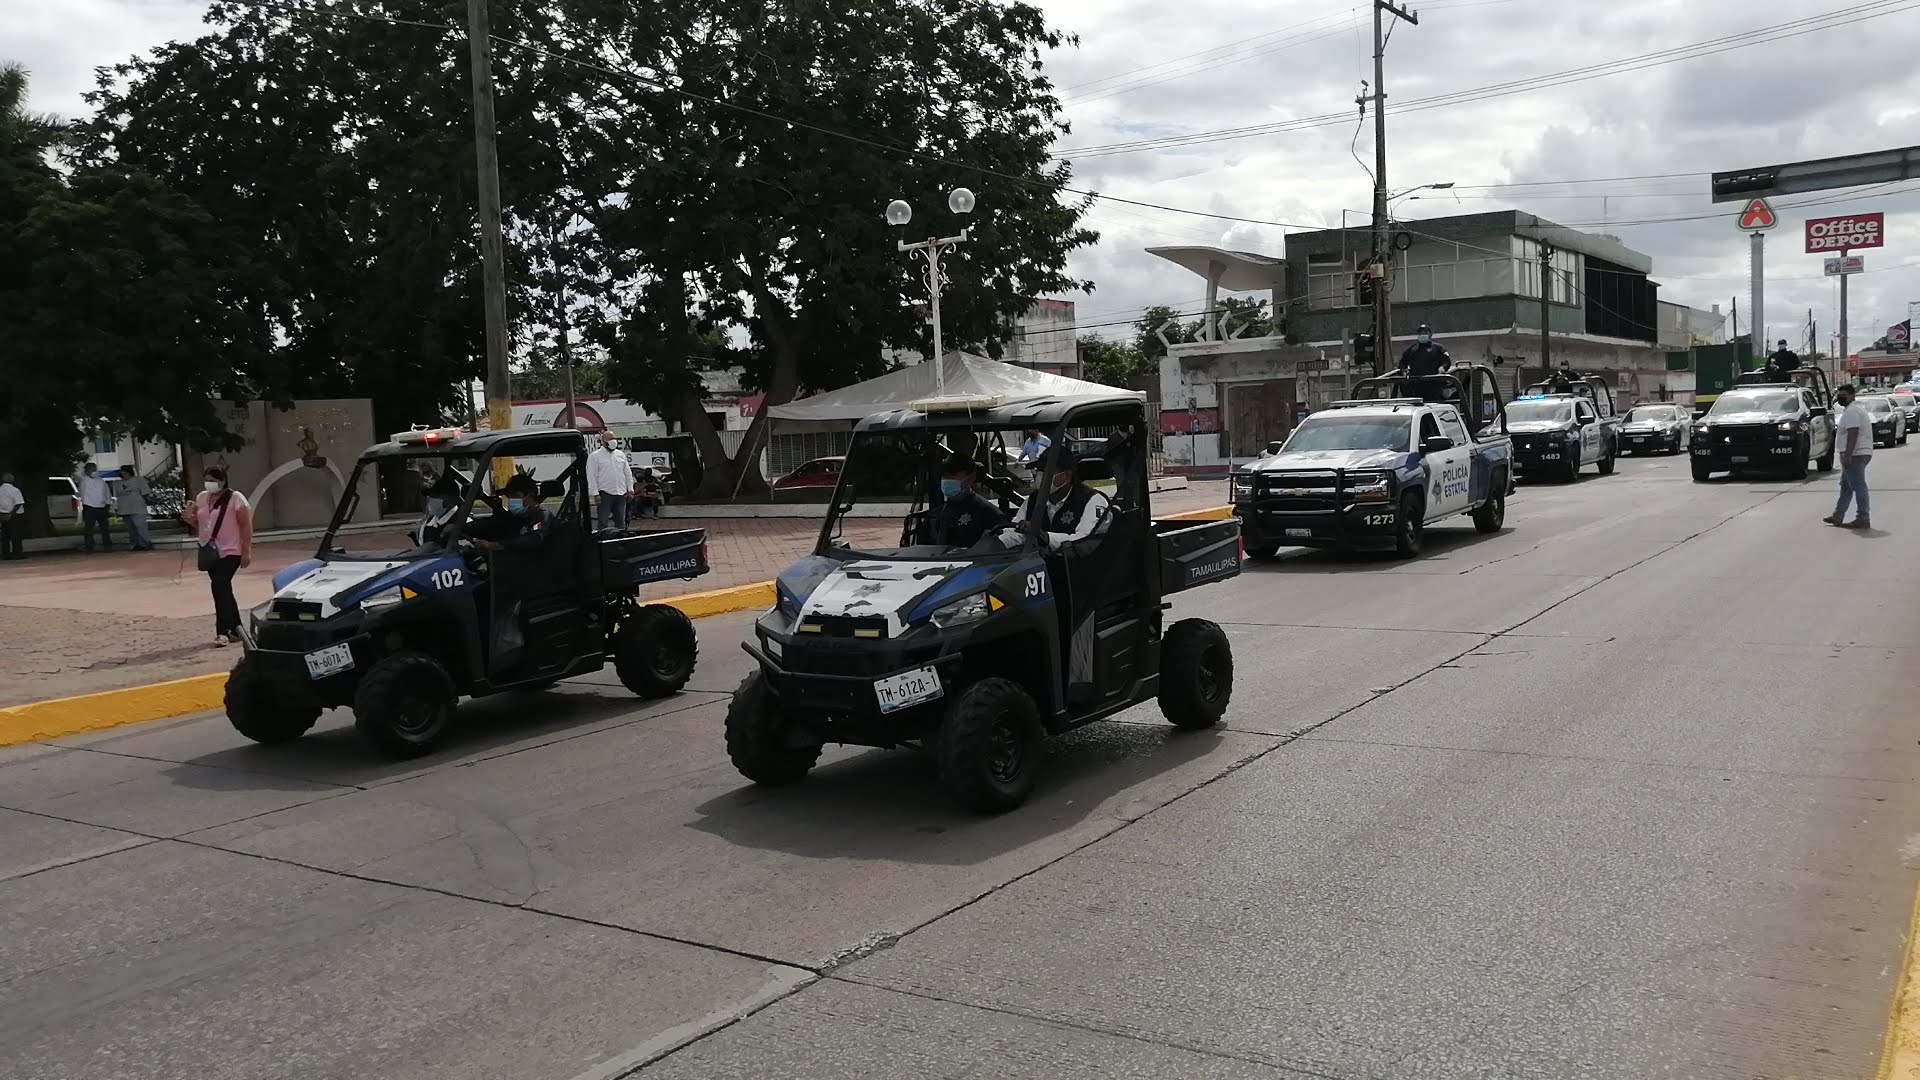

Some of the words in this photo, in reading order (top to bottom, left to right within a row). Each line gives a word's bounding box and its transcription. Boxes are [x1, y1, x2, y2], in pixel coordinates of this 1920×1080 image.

[1810, 219, 1878, 237] Office
[1810, 233, 1878, 249] DEPOT
[1768, 447, 1793, 456] 1485
[1444, 482, 1468, 498] ESTATAL
[1363, 514, 1395, 526] 1273
[639, 558, 698, 577] TAMAULIPAS
[1190, 556, 1237, 578] TAMAULIPAS
[431, 568, 464, 590] 102
[308, 650, 350, 672] TM-607A-1
[878, 674, 938, 704] TM-612A-1
